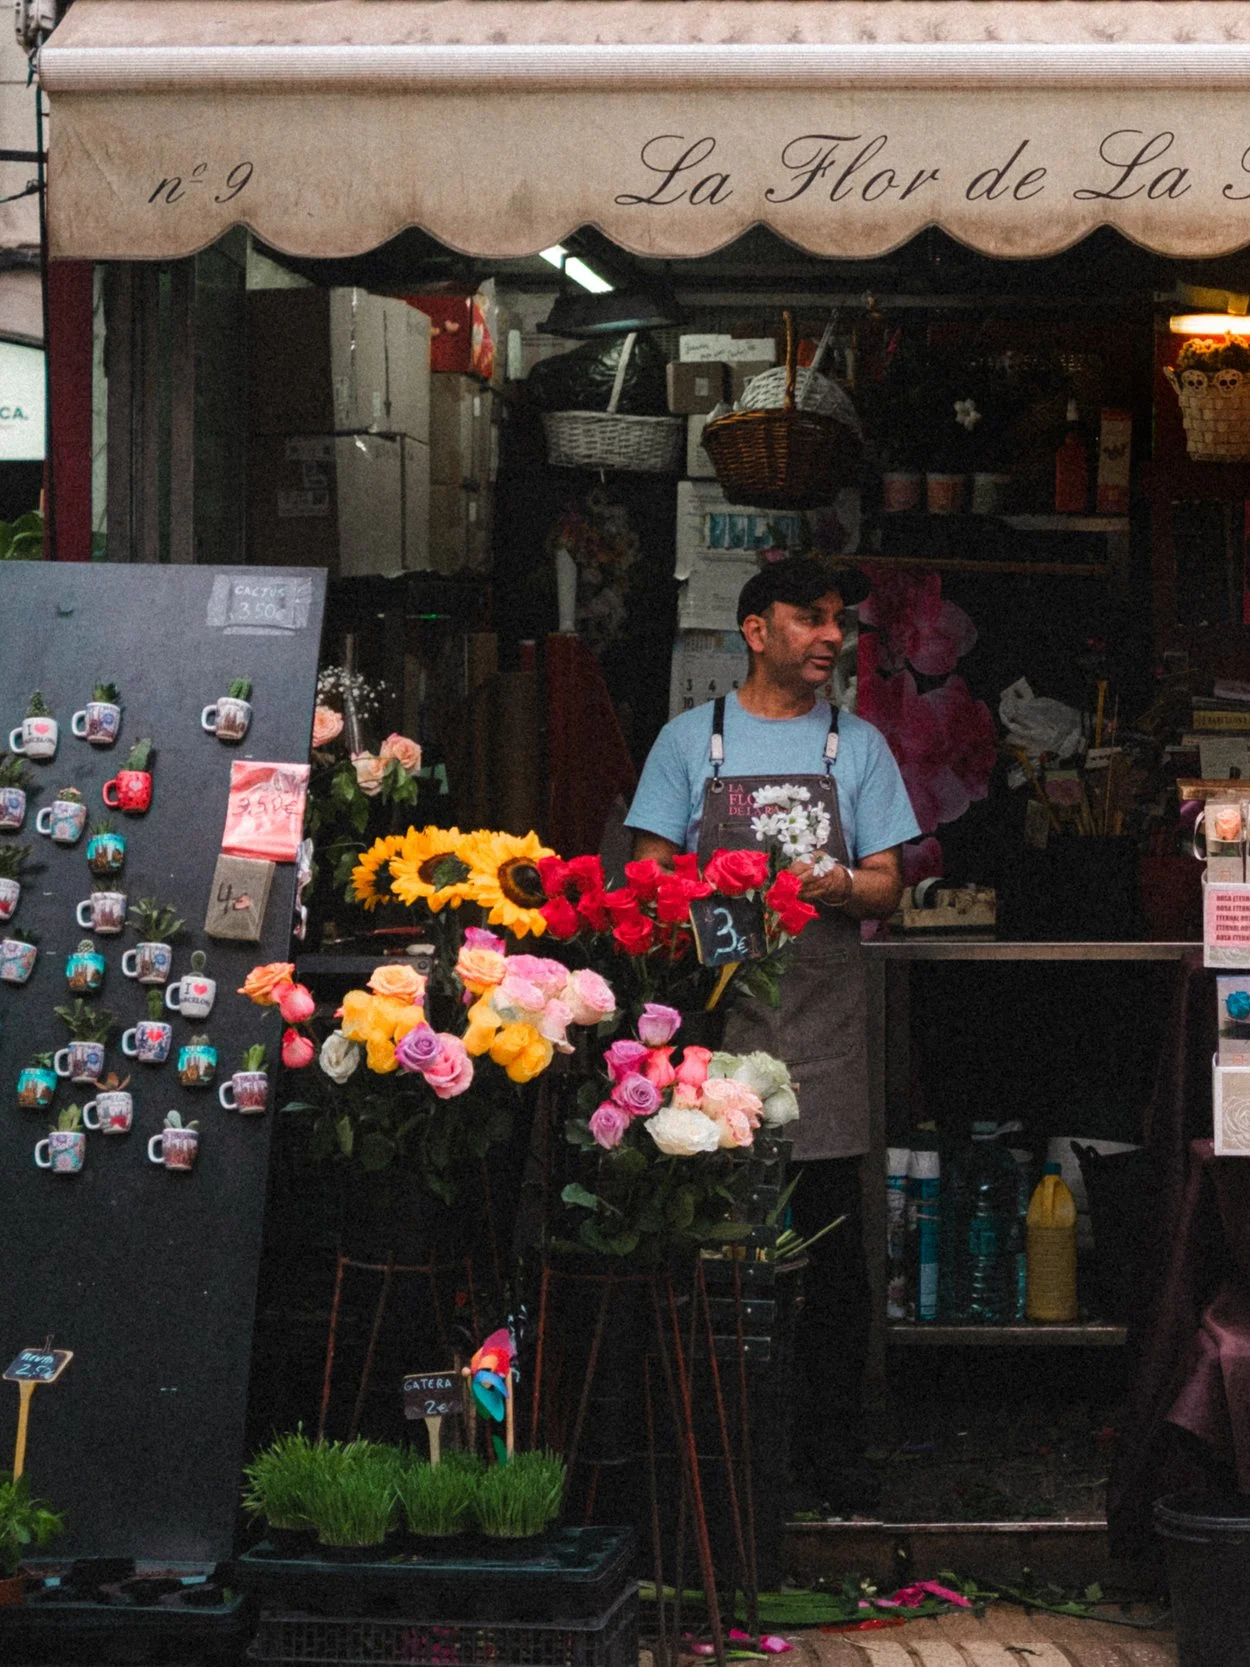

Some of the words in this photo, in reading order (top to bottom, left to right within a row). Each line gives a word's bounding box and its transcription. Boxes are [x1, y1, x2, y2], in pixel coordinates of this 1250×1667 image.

[615, 134, 734, 206] La
[764, 134, 940, 204] Flor
[965, 140, 1048, 202] de
[1073, 129, 1191, 200] La
[214, 161, 254, 204] 9
[234, 585, 288, 597] CACTUS
[728, 784, 744, 793] LA
[712, 906, 750, 959] 3€
[404, 1378, 452, 1392] GATERA
[424, 1400, 449, 1415] 2€
